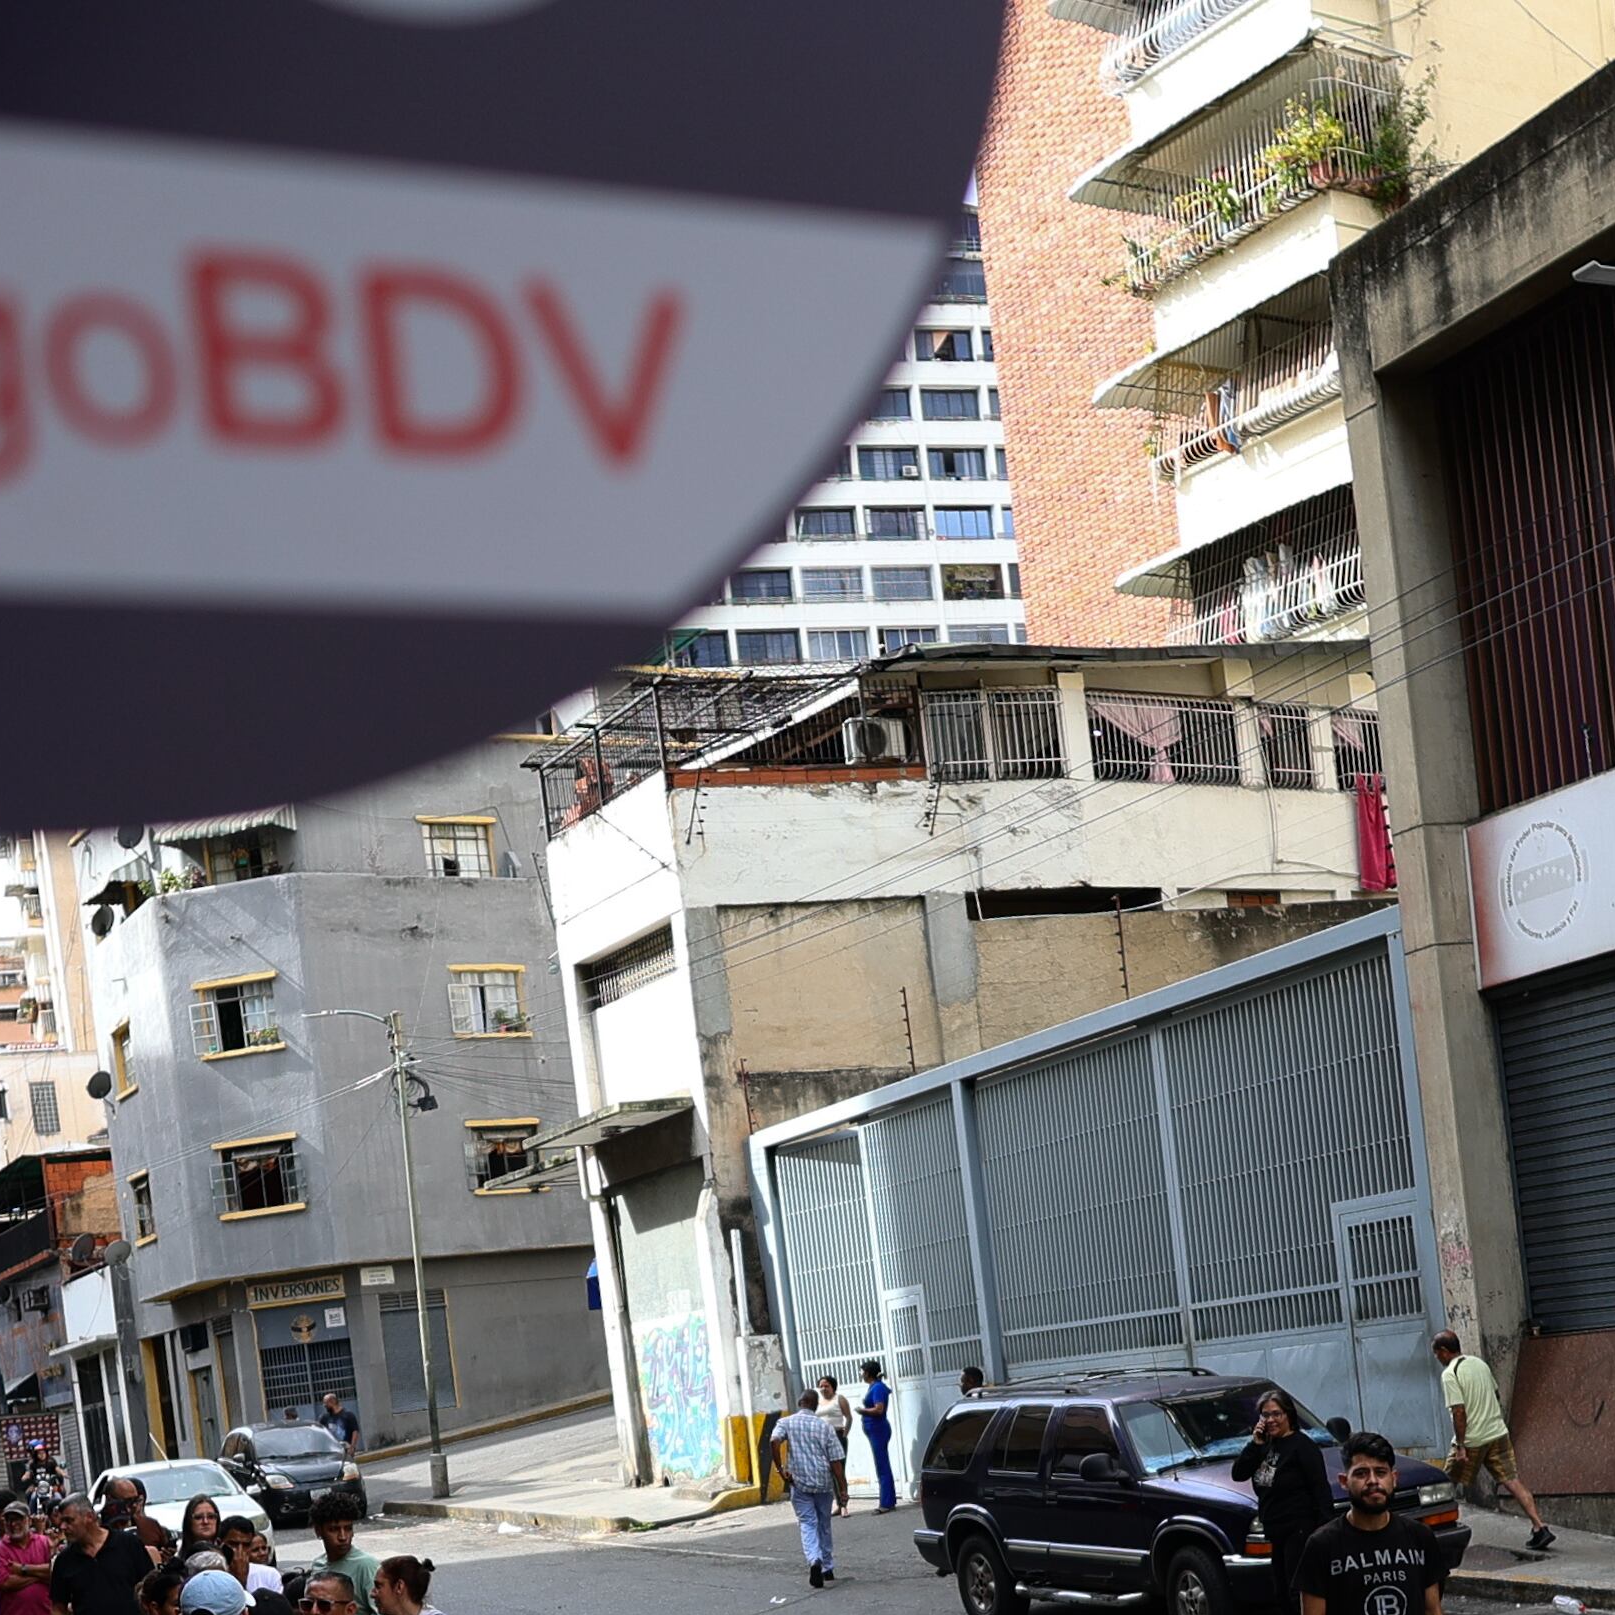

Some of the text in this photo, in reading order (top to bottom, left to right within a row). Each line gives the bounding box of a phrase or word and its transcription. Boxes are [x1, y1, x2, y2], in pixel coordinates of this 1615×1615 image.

[253, 1278, 341, 1302] INVERSIONES
[1330, 1548, 1426, 1577] BALMAIN
[1363, 1569, 1407, 1585] PARIS
